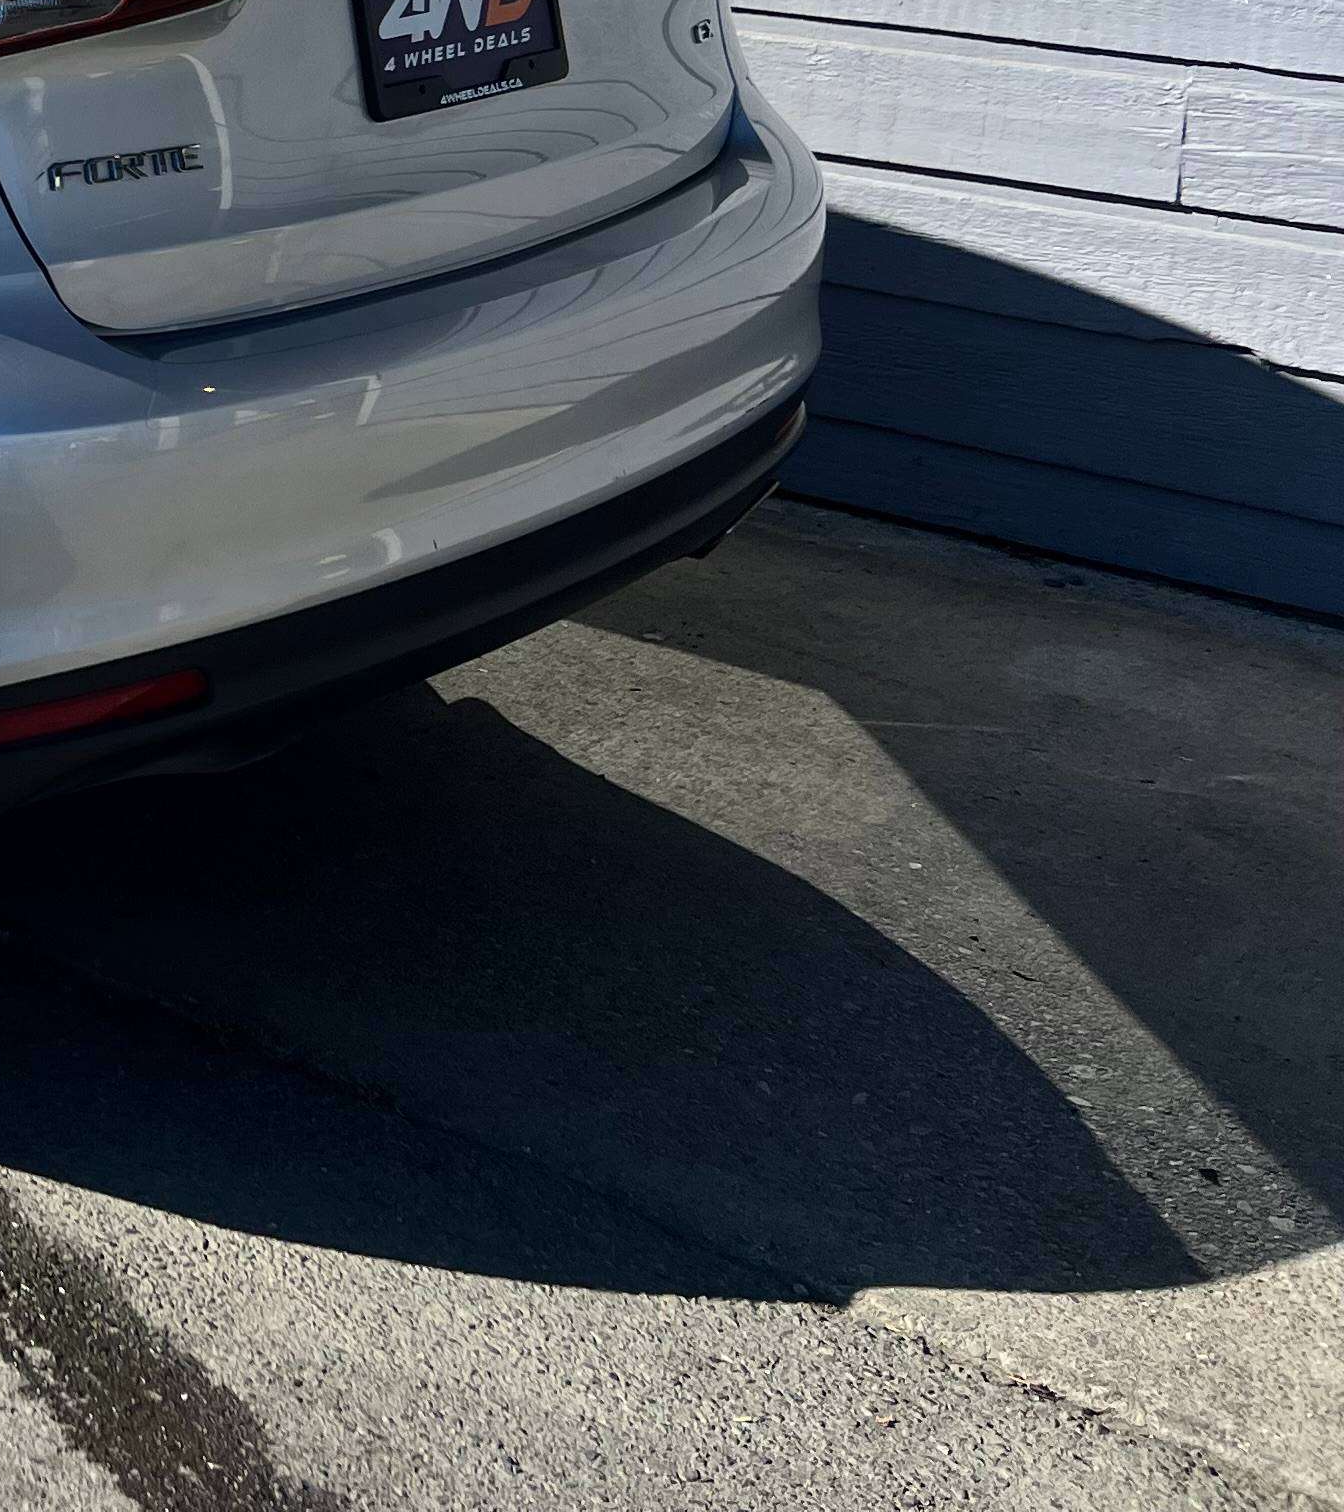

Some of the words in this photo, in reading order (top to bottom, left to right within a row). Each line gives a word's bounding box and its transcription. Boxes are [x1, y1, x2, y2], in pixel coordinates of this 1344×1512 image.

[384, 57, 396, 72] 4
[404, 42, 466, 69] WHEEL
[474, 27, 532, 53] DEALS
[46, 143, 204, 192] FORTE
